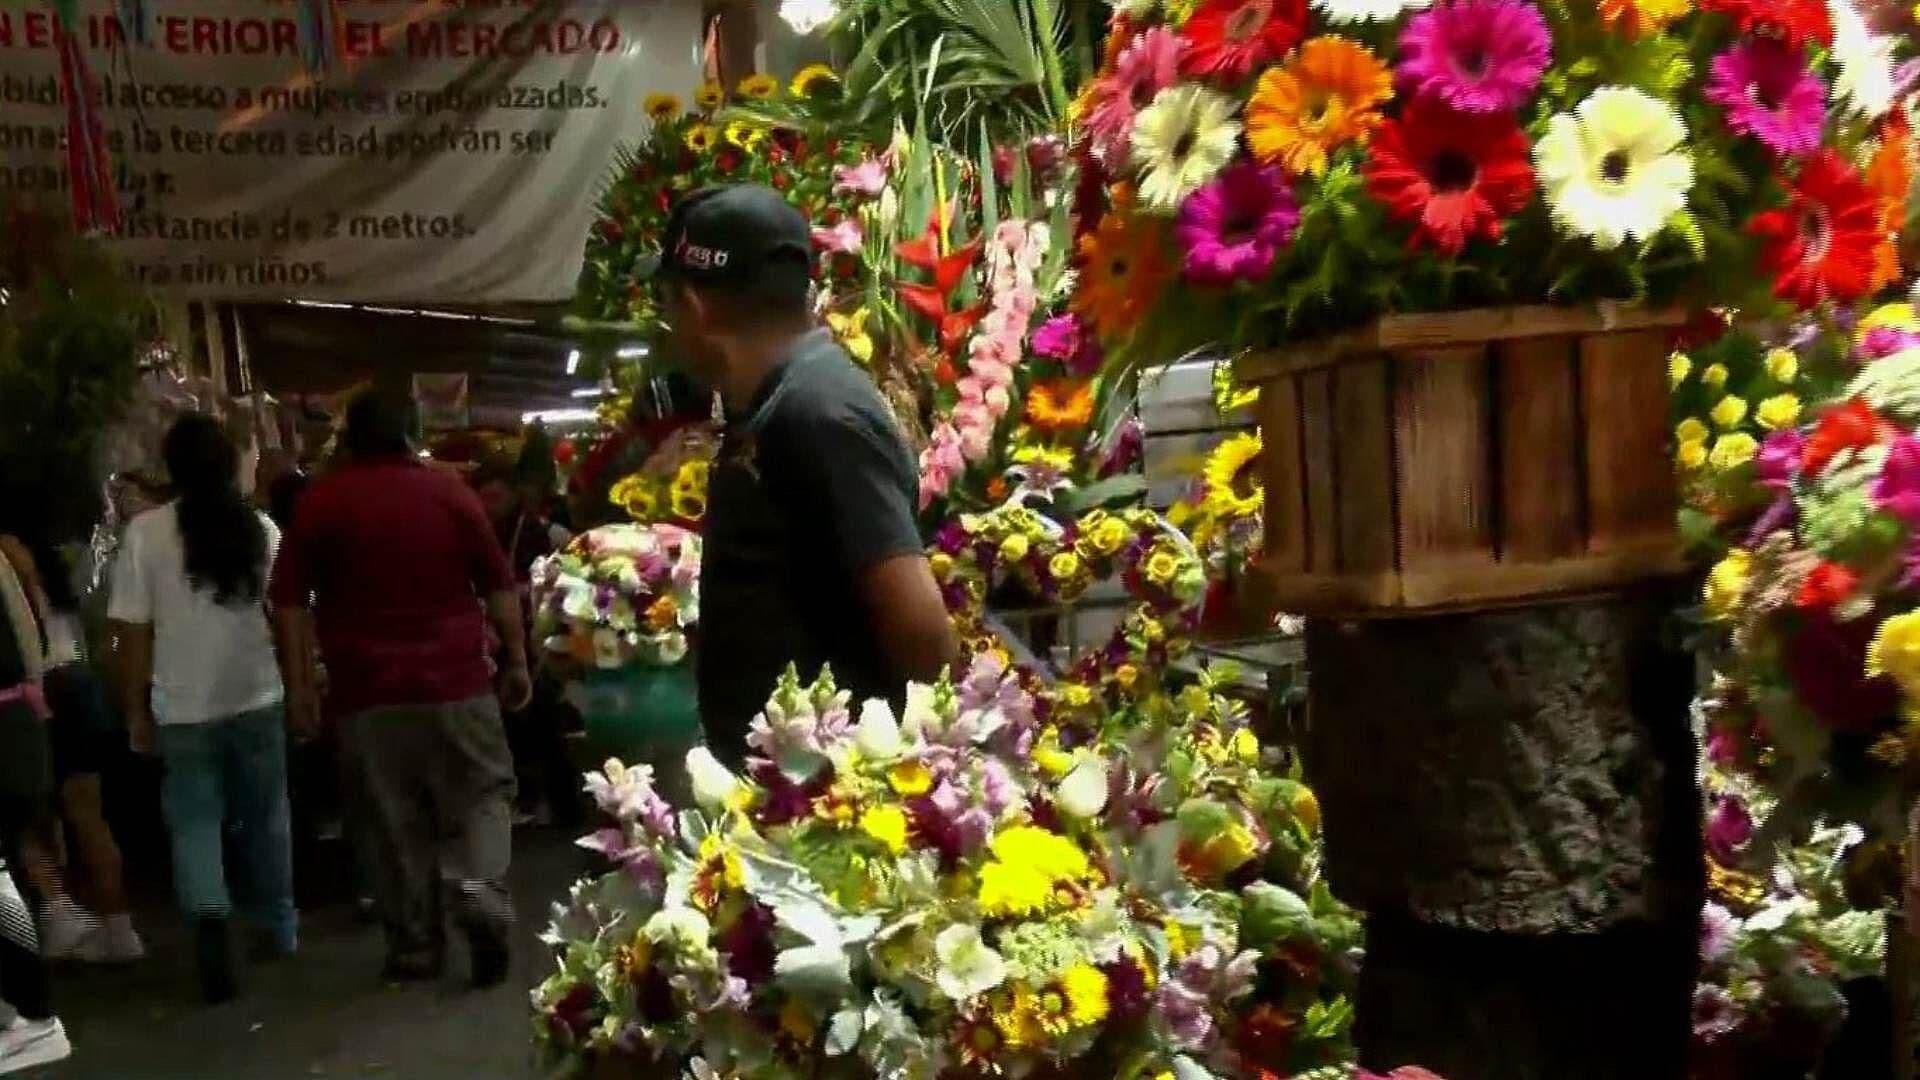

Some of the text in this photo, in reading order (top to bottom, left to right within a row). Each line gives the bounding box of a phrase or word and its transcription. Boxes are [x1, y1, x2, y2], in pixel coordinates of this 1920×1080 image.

[88, 13, 299, 56] INERIOR
[407, 18, 619, 58] MERCADO
[134, 120, 162, 153] la
[171, 124, 286, 154] tercera
[296, 125, 378, 155] edad
[511, 128, 558, 154] ser
[118, 208, 260, 240] istancia
[271, 208, 312, 240] de
[321, 211, 340, 236] 2
